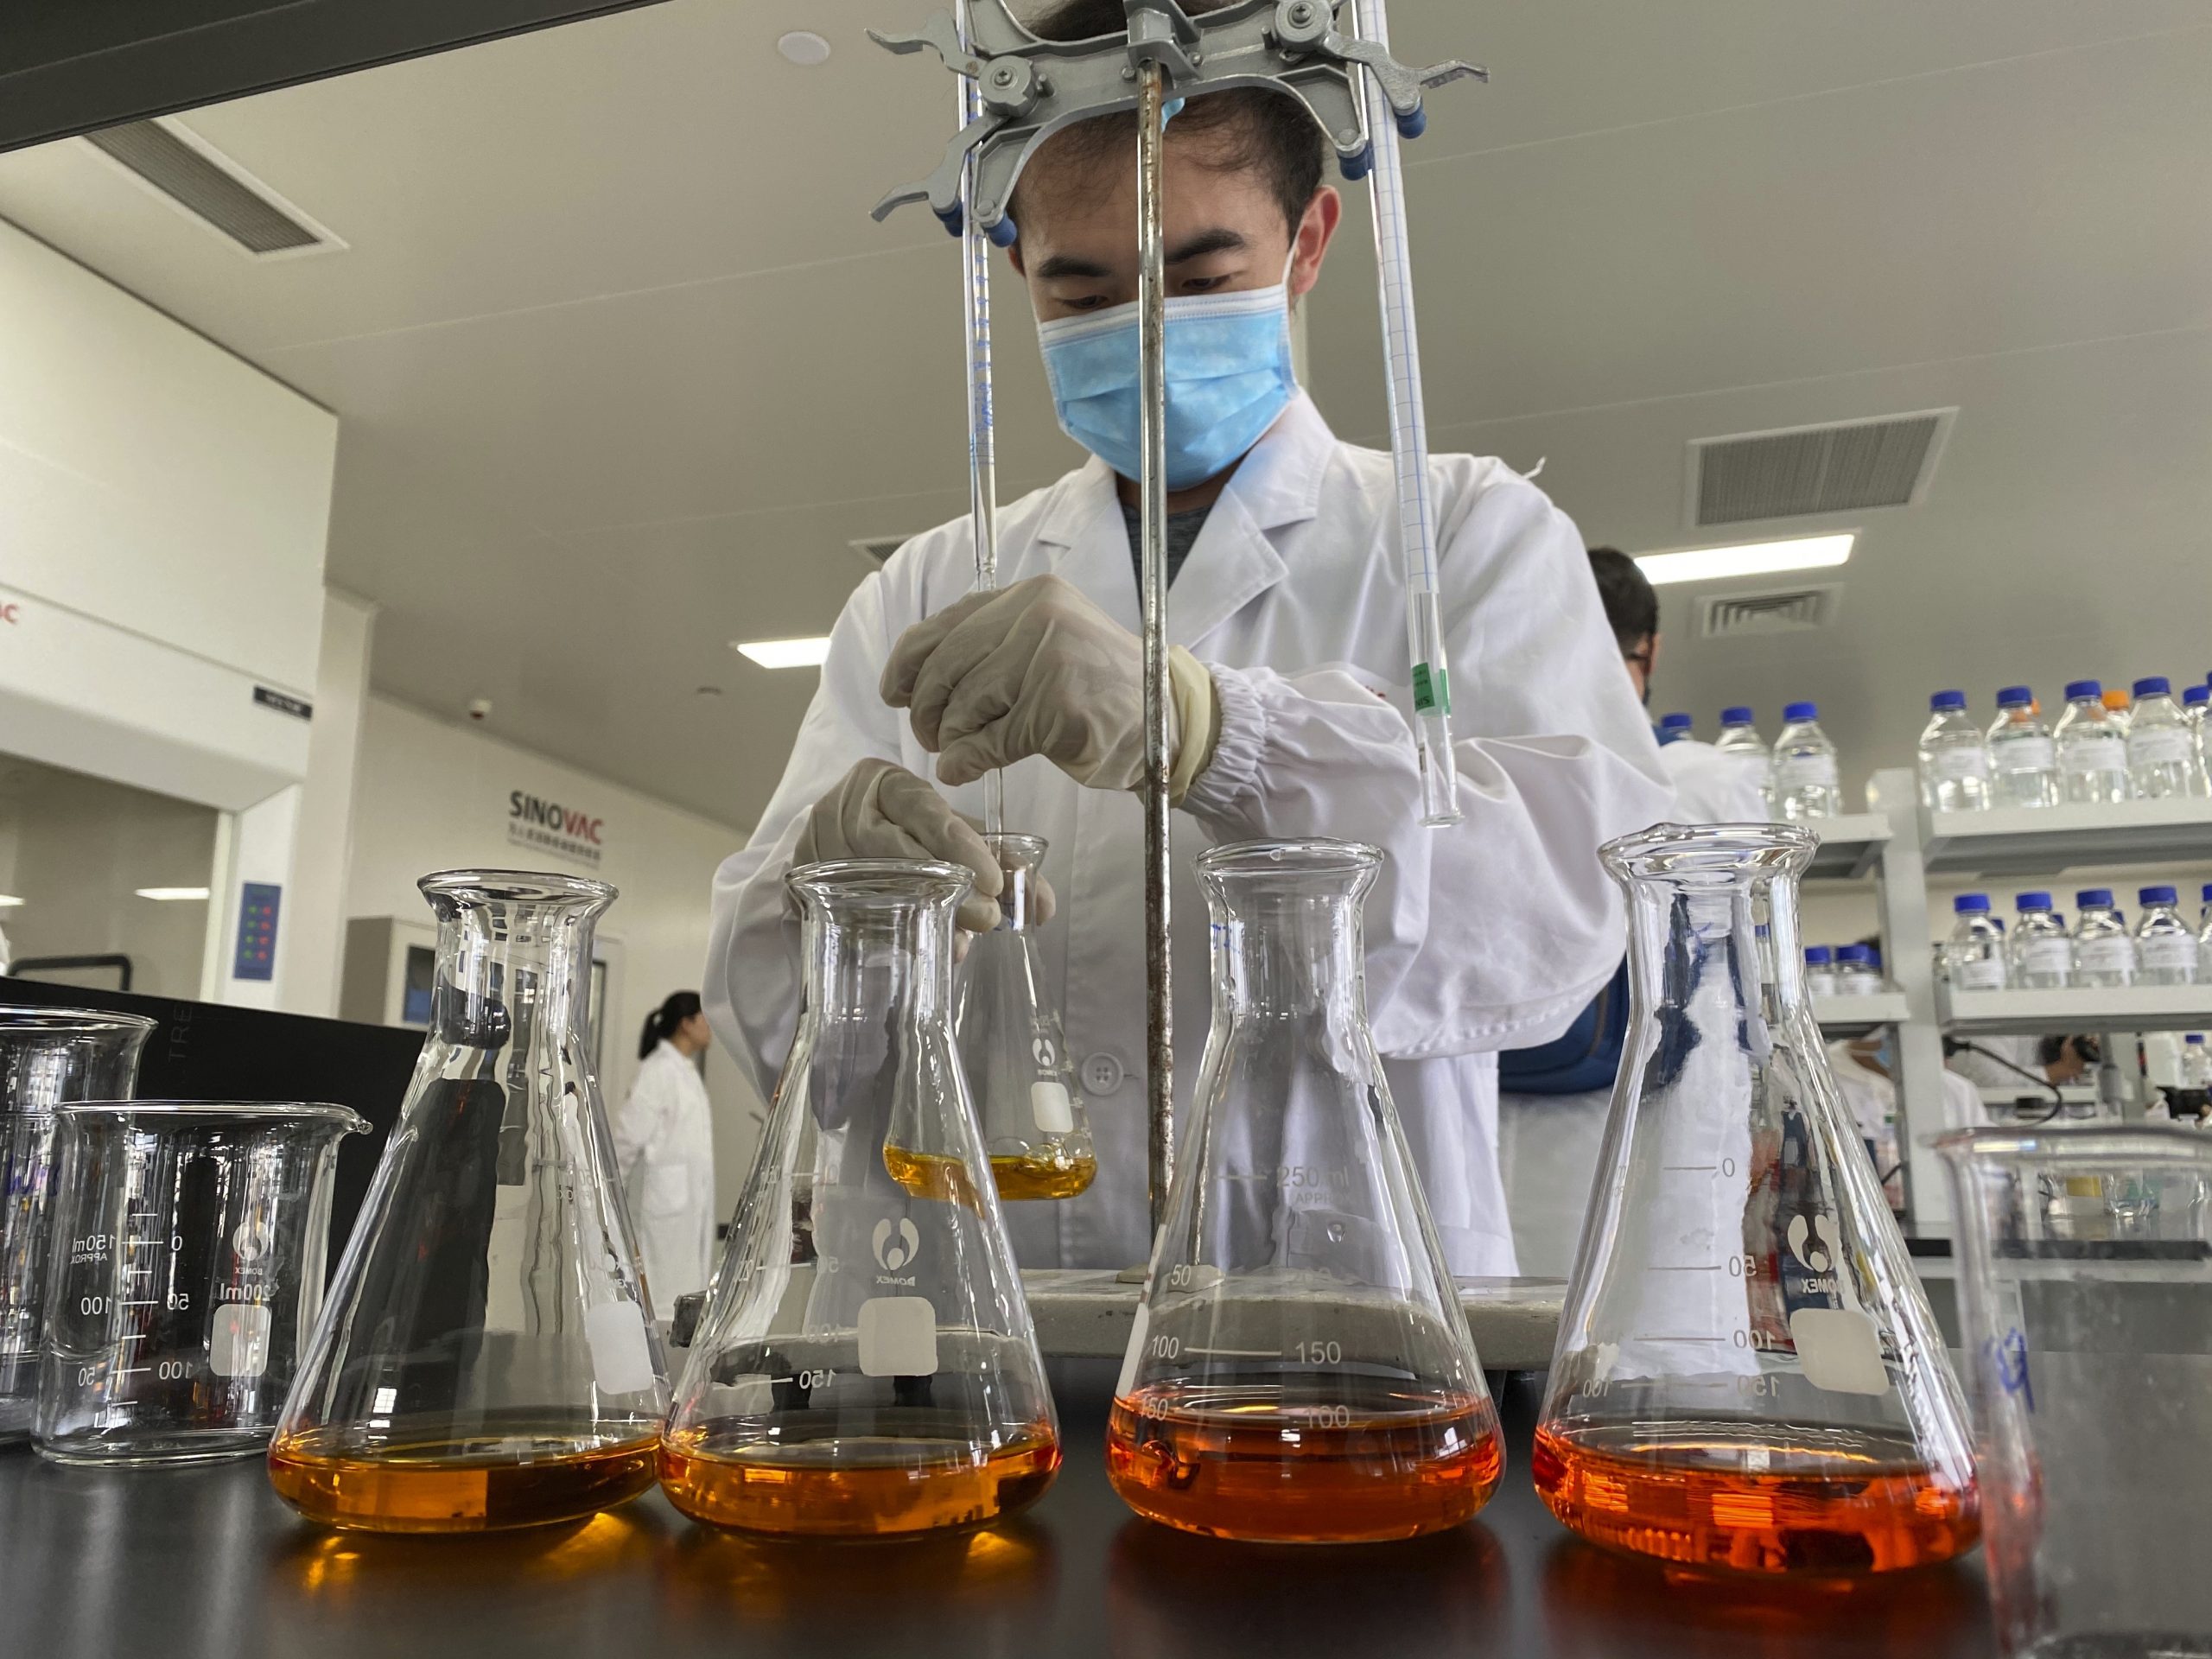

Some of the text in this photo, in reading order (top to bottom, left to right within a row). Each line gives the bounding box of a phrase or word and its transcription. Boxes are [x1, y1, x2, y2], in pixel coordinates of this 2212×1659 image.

[509, 790, 604, 846] SINOVAC
[1277, 1166, 1319, 1188] 250
[1171, 1264, 1192, 1287] 50
[1152, 1335, 1179, 1359] 100
[1295, 1341, 1342, 1365] 150
[1140, 1395, 1168, 1421] 150
[1305, 1405, 1350, 1429] 100
